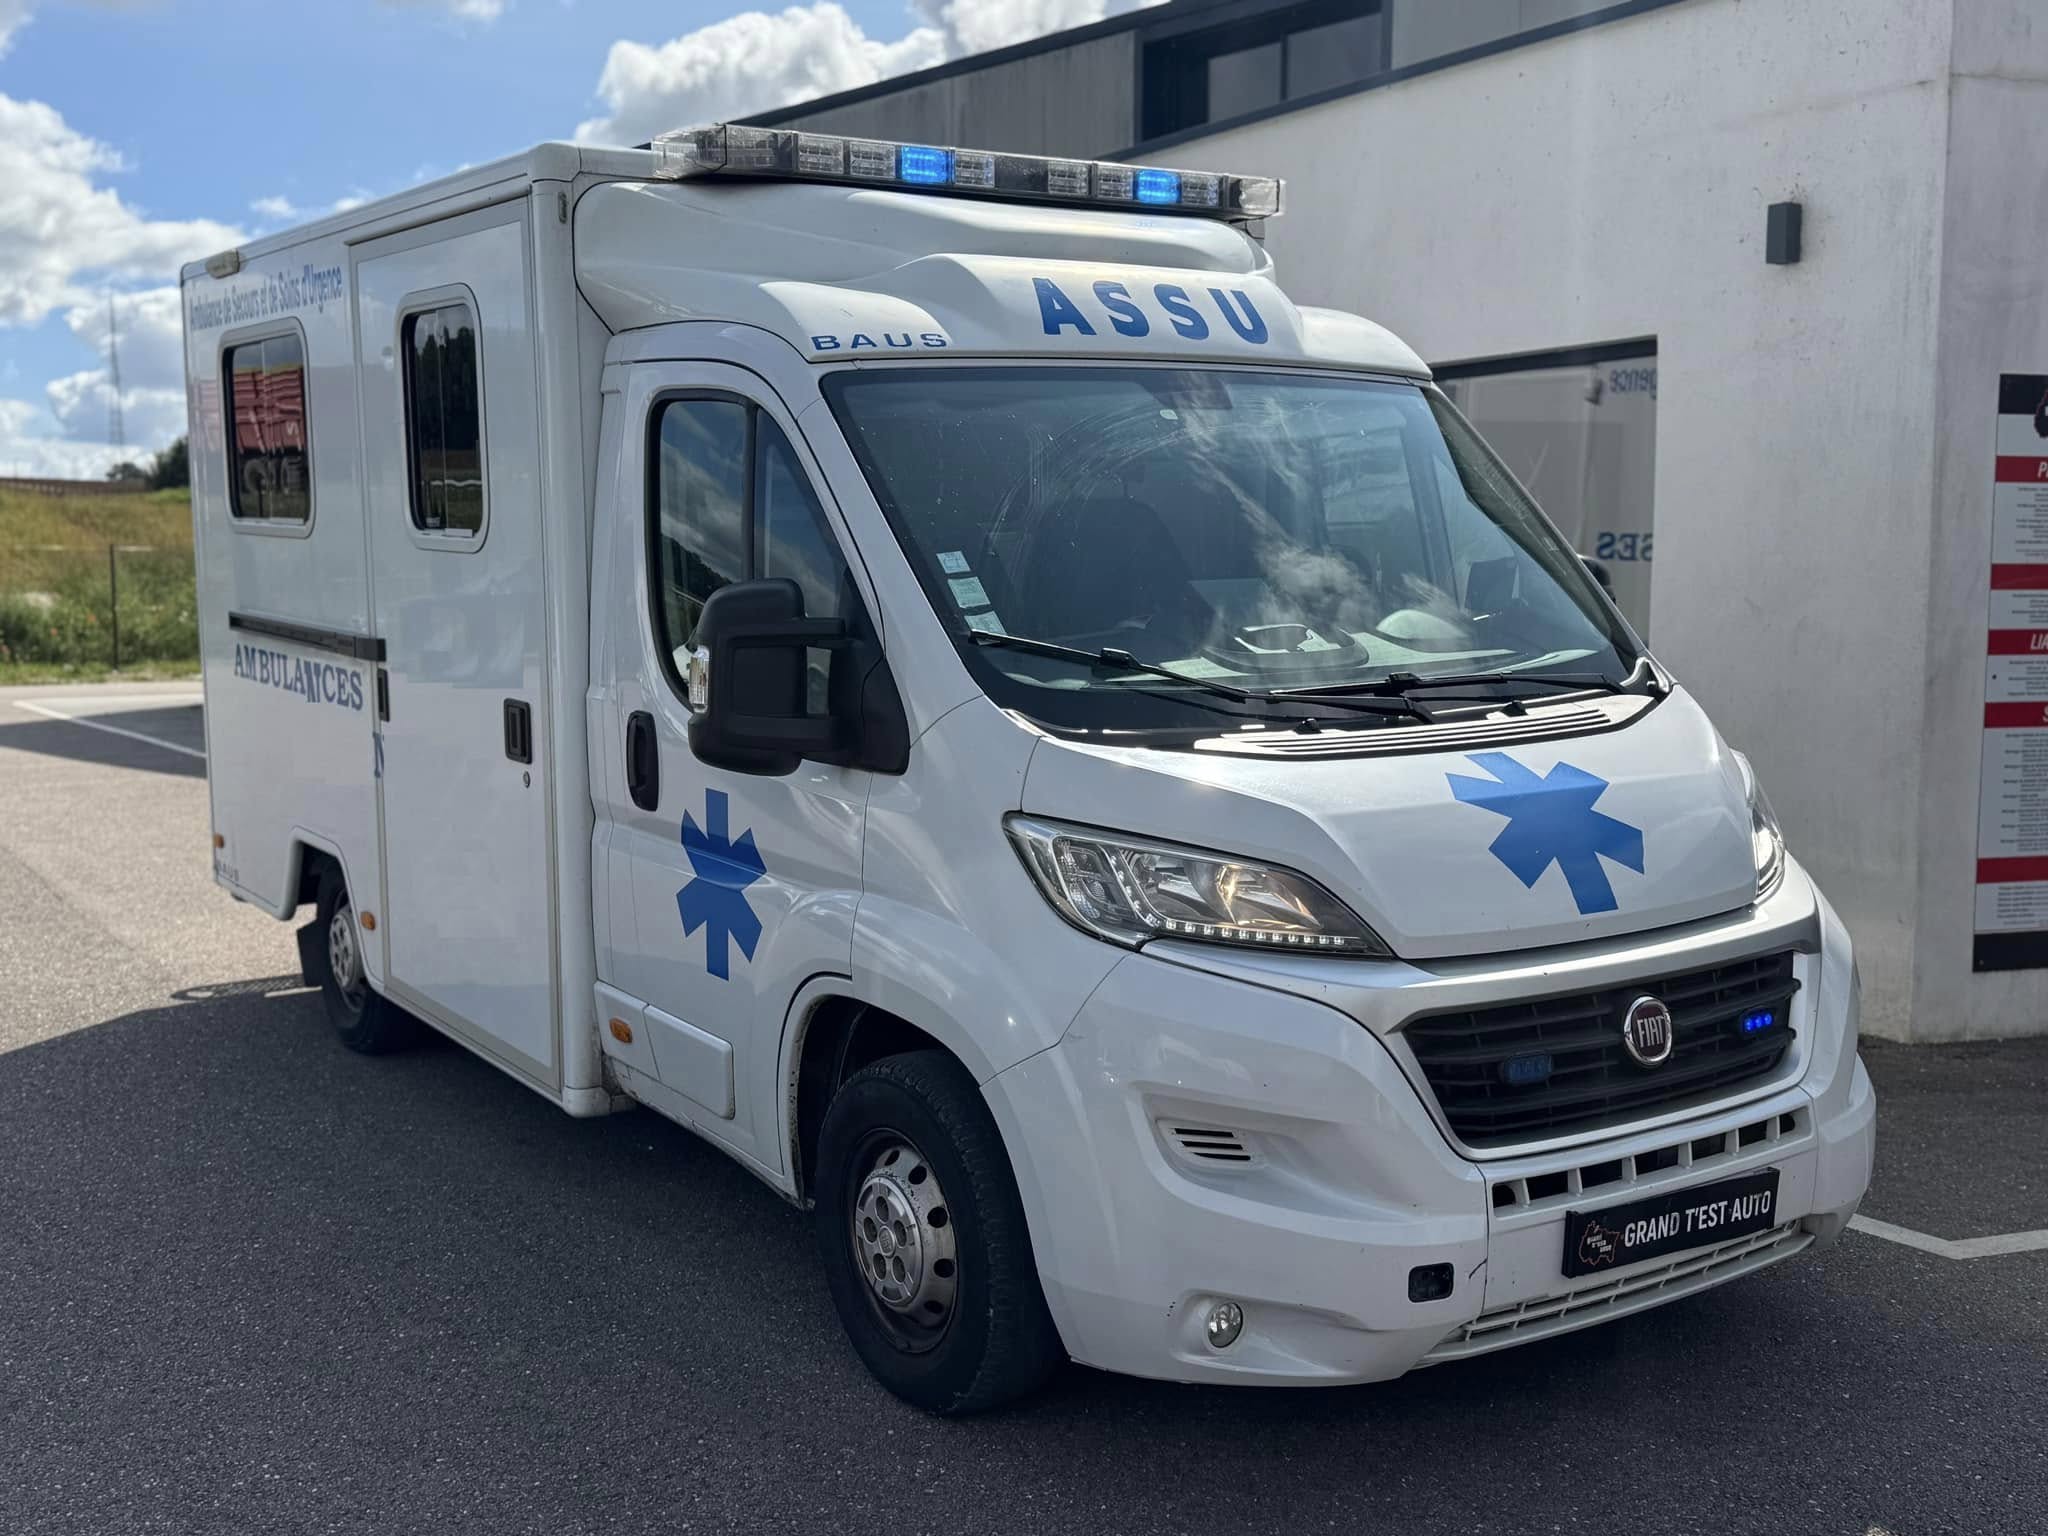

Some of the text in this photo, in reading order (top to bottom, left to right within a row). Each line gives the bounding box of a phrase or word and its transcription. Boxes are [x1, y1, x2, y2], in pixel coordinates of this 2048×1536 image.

[232, 284, 260, 322] Secours
[269, 273, 278, 314] de
[278, 269, 301, 312] Soins
[302, 264, 343, 314] d'Urgence
[1031, 277, 1269, 345] ASSU
[811, 333, 947, 350] BAUS
[234, 643, 364, 711] AMBULANCES
[1636, 1015, 1665, 1048] FIAT
[1624, 1211, 1681, 1248] GRAND
[1685, 1200, 1729, 1233] T'EST
[1731, 1190, 1771, 1223] AUTO
